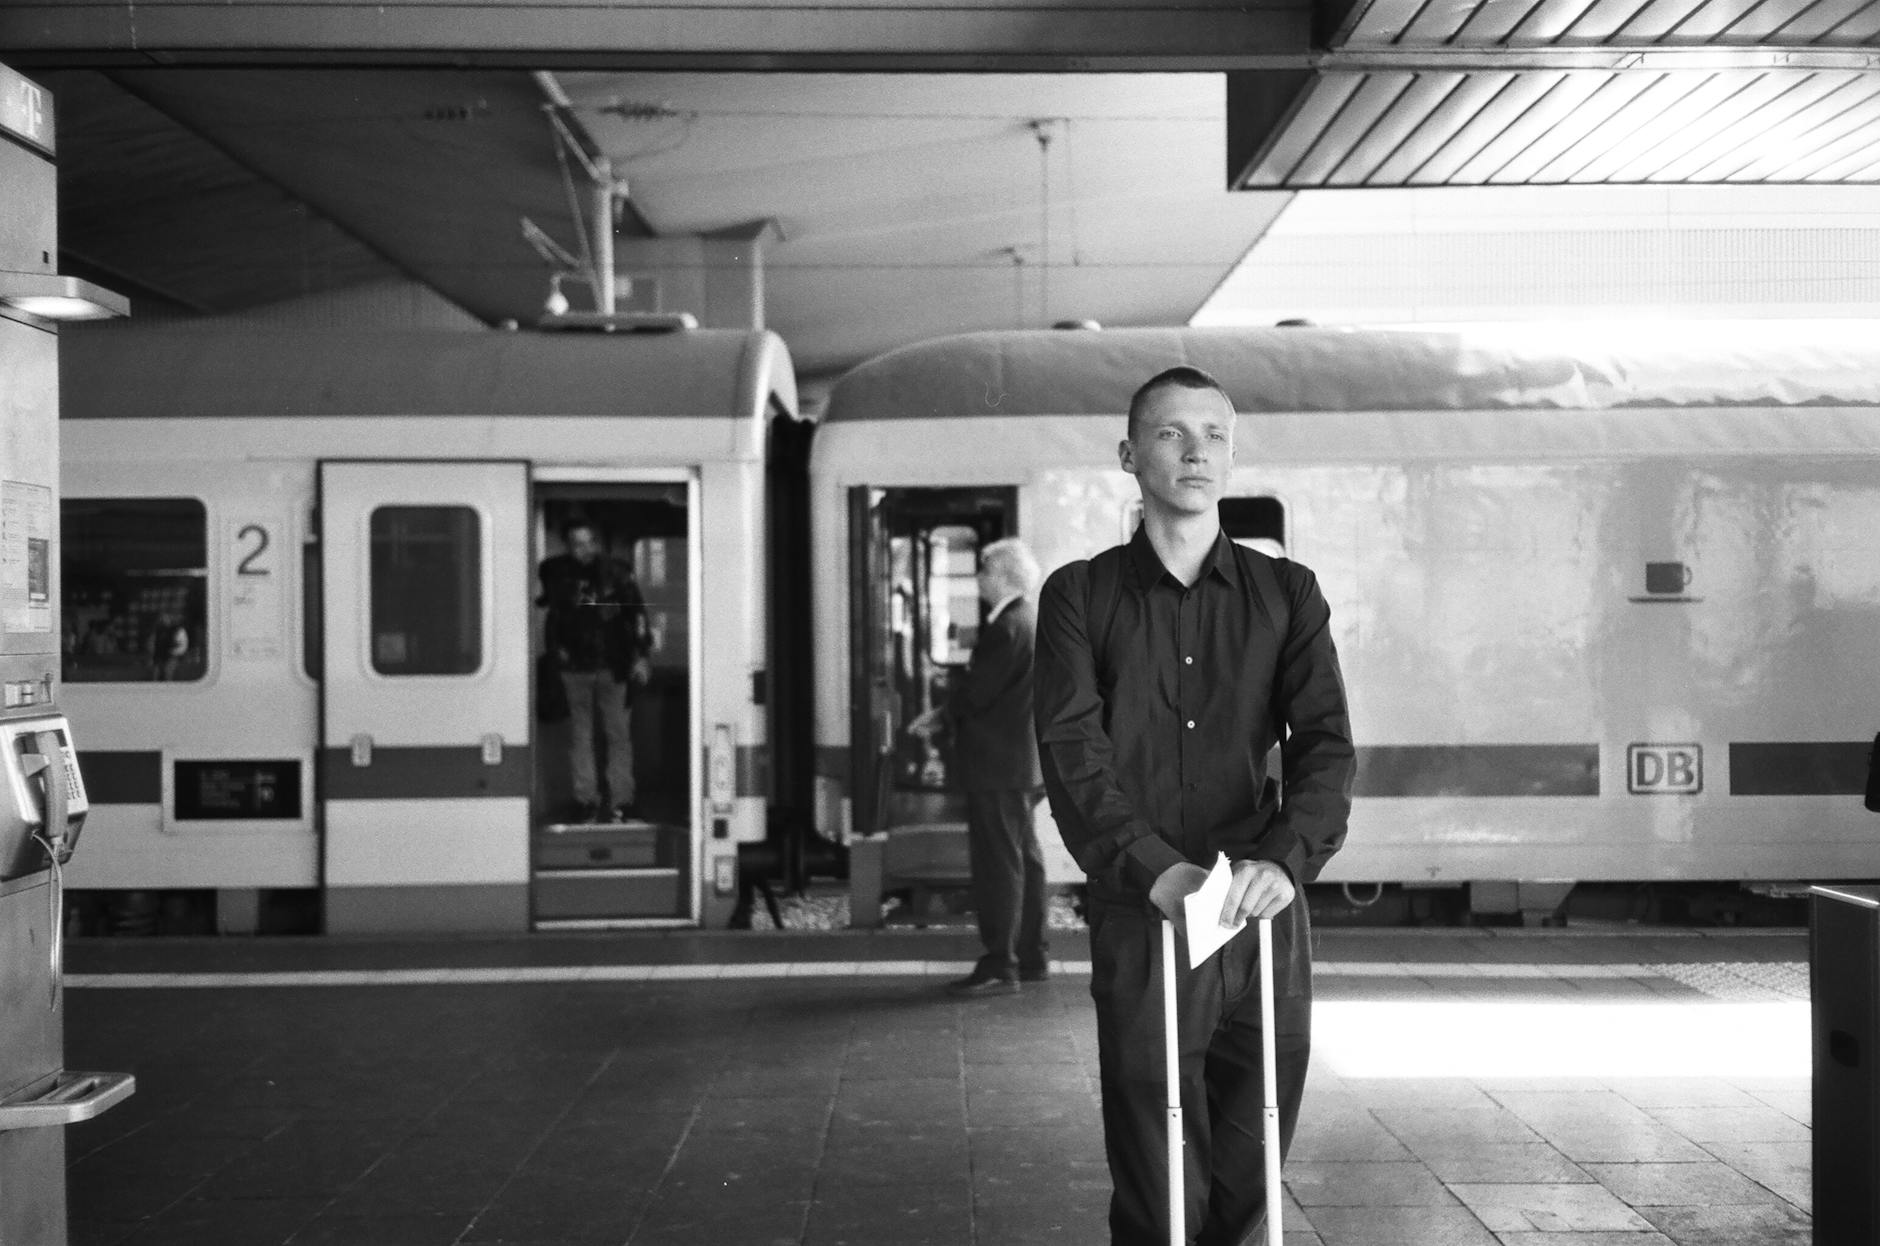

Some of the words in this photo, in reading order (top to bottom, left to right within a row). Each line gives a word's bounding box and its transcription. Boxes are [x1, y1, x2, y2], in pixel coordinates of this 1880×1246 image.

[20, 80, 42, 139] T
[237, 524, 271, 576] 2
[1636, 750, 1695, 787] DB
